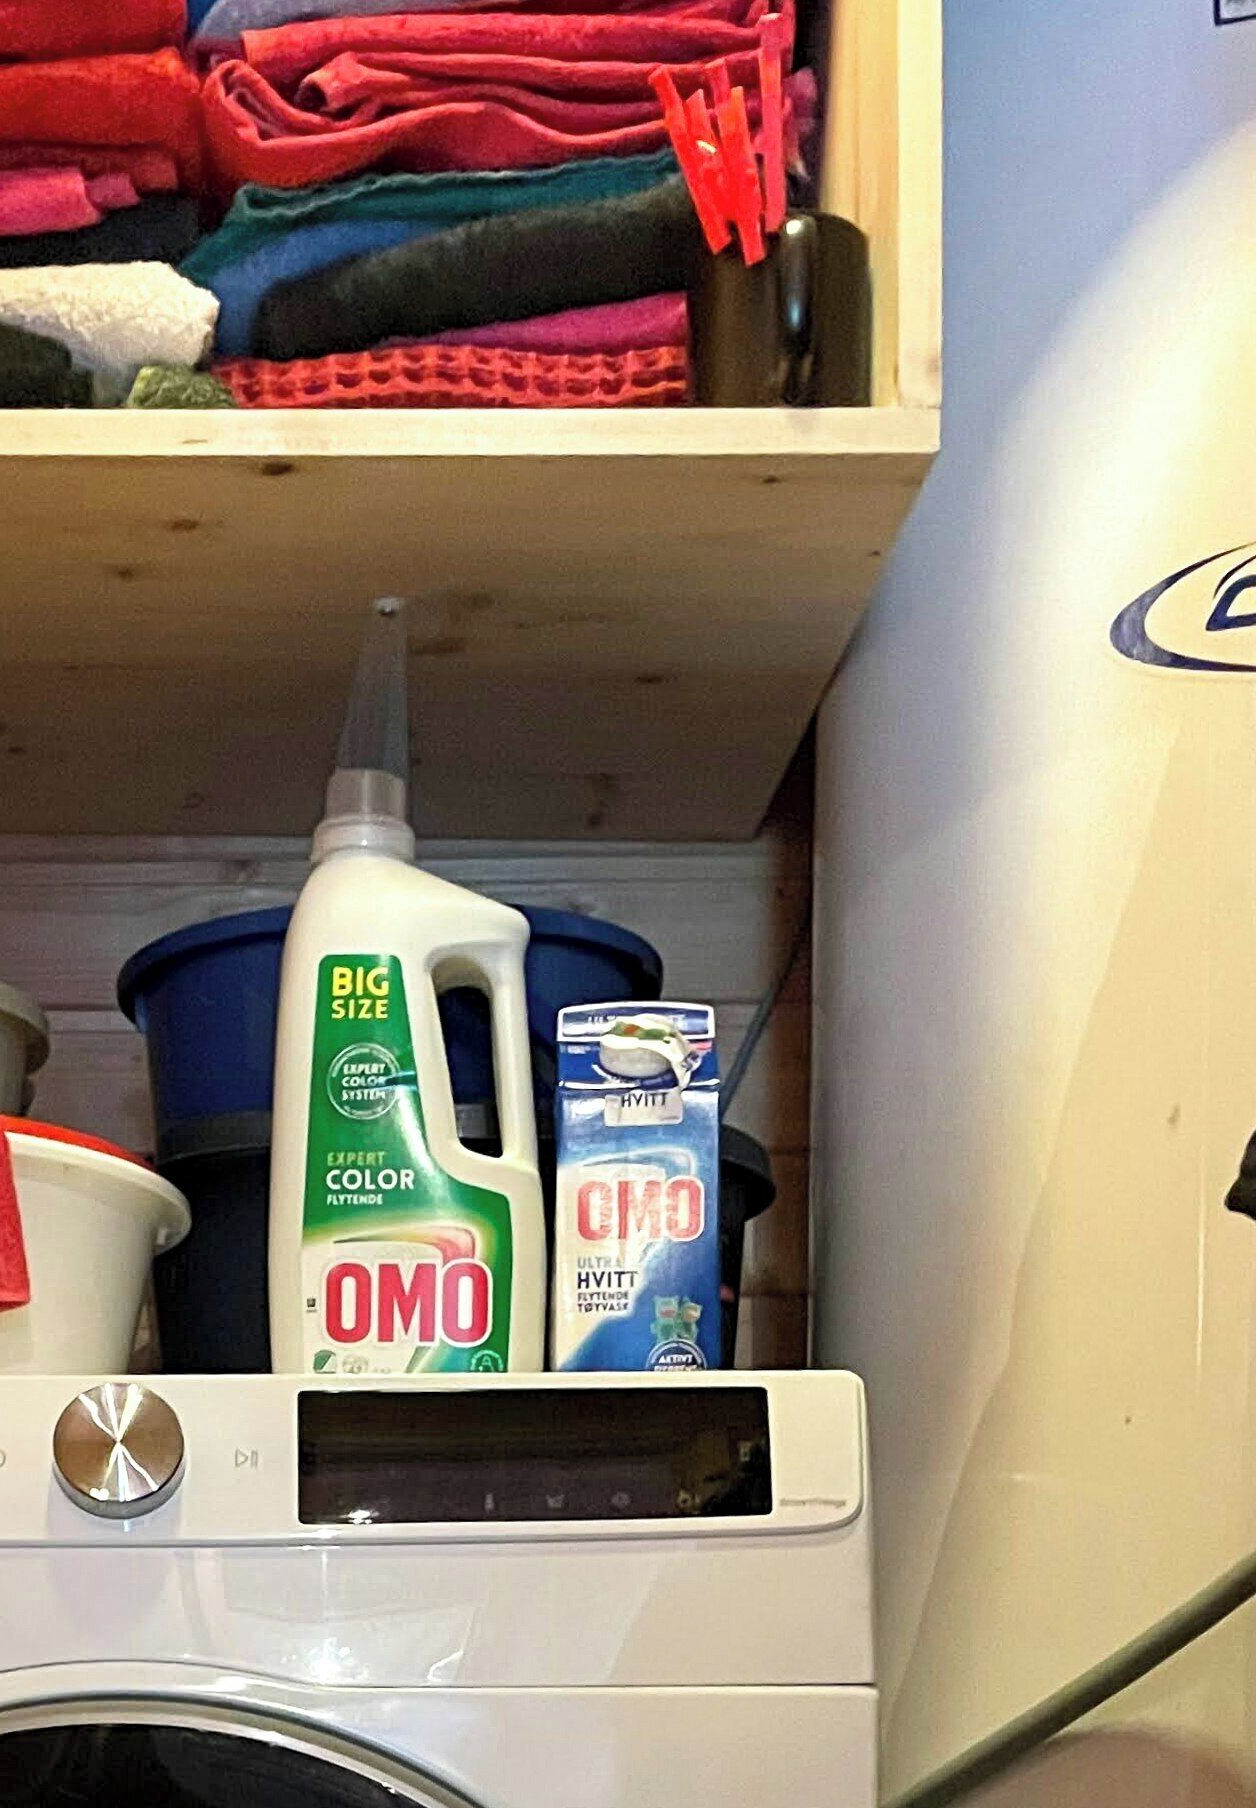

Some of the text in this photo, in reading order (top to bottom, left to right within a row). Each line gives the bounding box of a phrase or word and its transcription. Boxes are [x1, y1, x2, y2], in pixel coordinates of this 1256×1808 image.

[332, 966, 390, 997] BIG
[331, 999, 389, 1019] SIZE
[343, 1063, 386, 1075] EXPERT
[621, 1092, 669, 1108] HVITT
[327, 1151, 386, 1166] EXPERT
[326, 1169, 415, 1191] COLOR
[326, 1194, 384, 1206] FLYTENDE
[577, 1179, 703, 1241] OMO
[577, 1271, 639, 1290] HVITT
[325, 1262, 490, 1344] OMO
[577, 1291, 630, 1302] FLYTENDE
